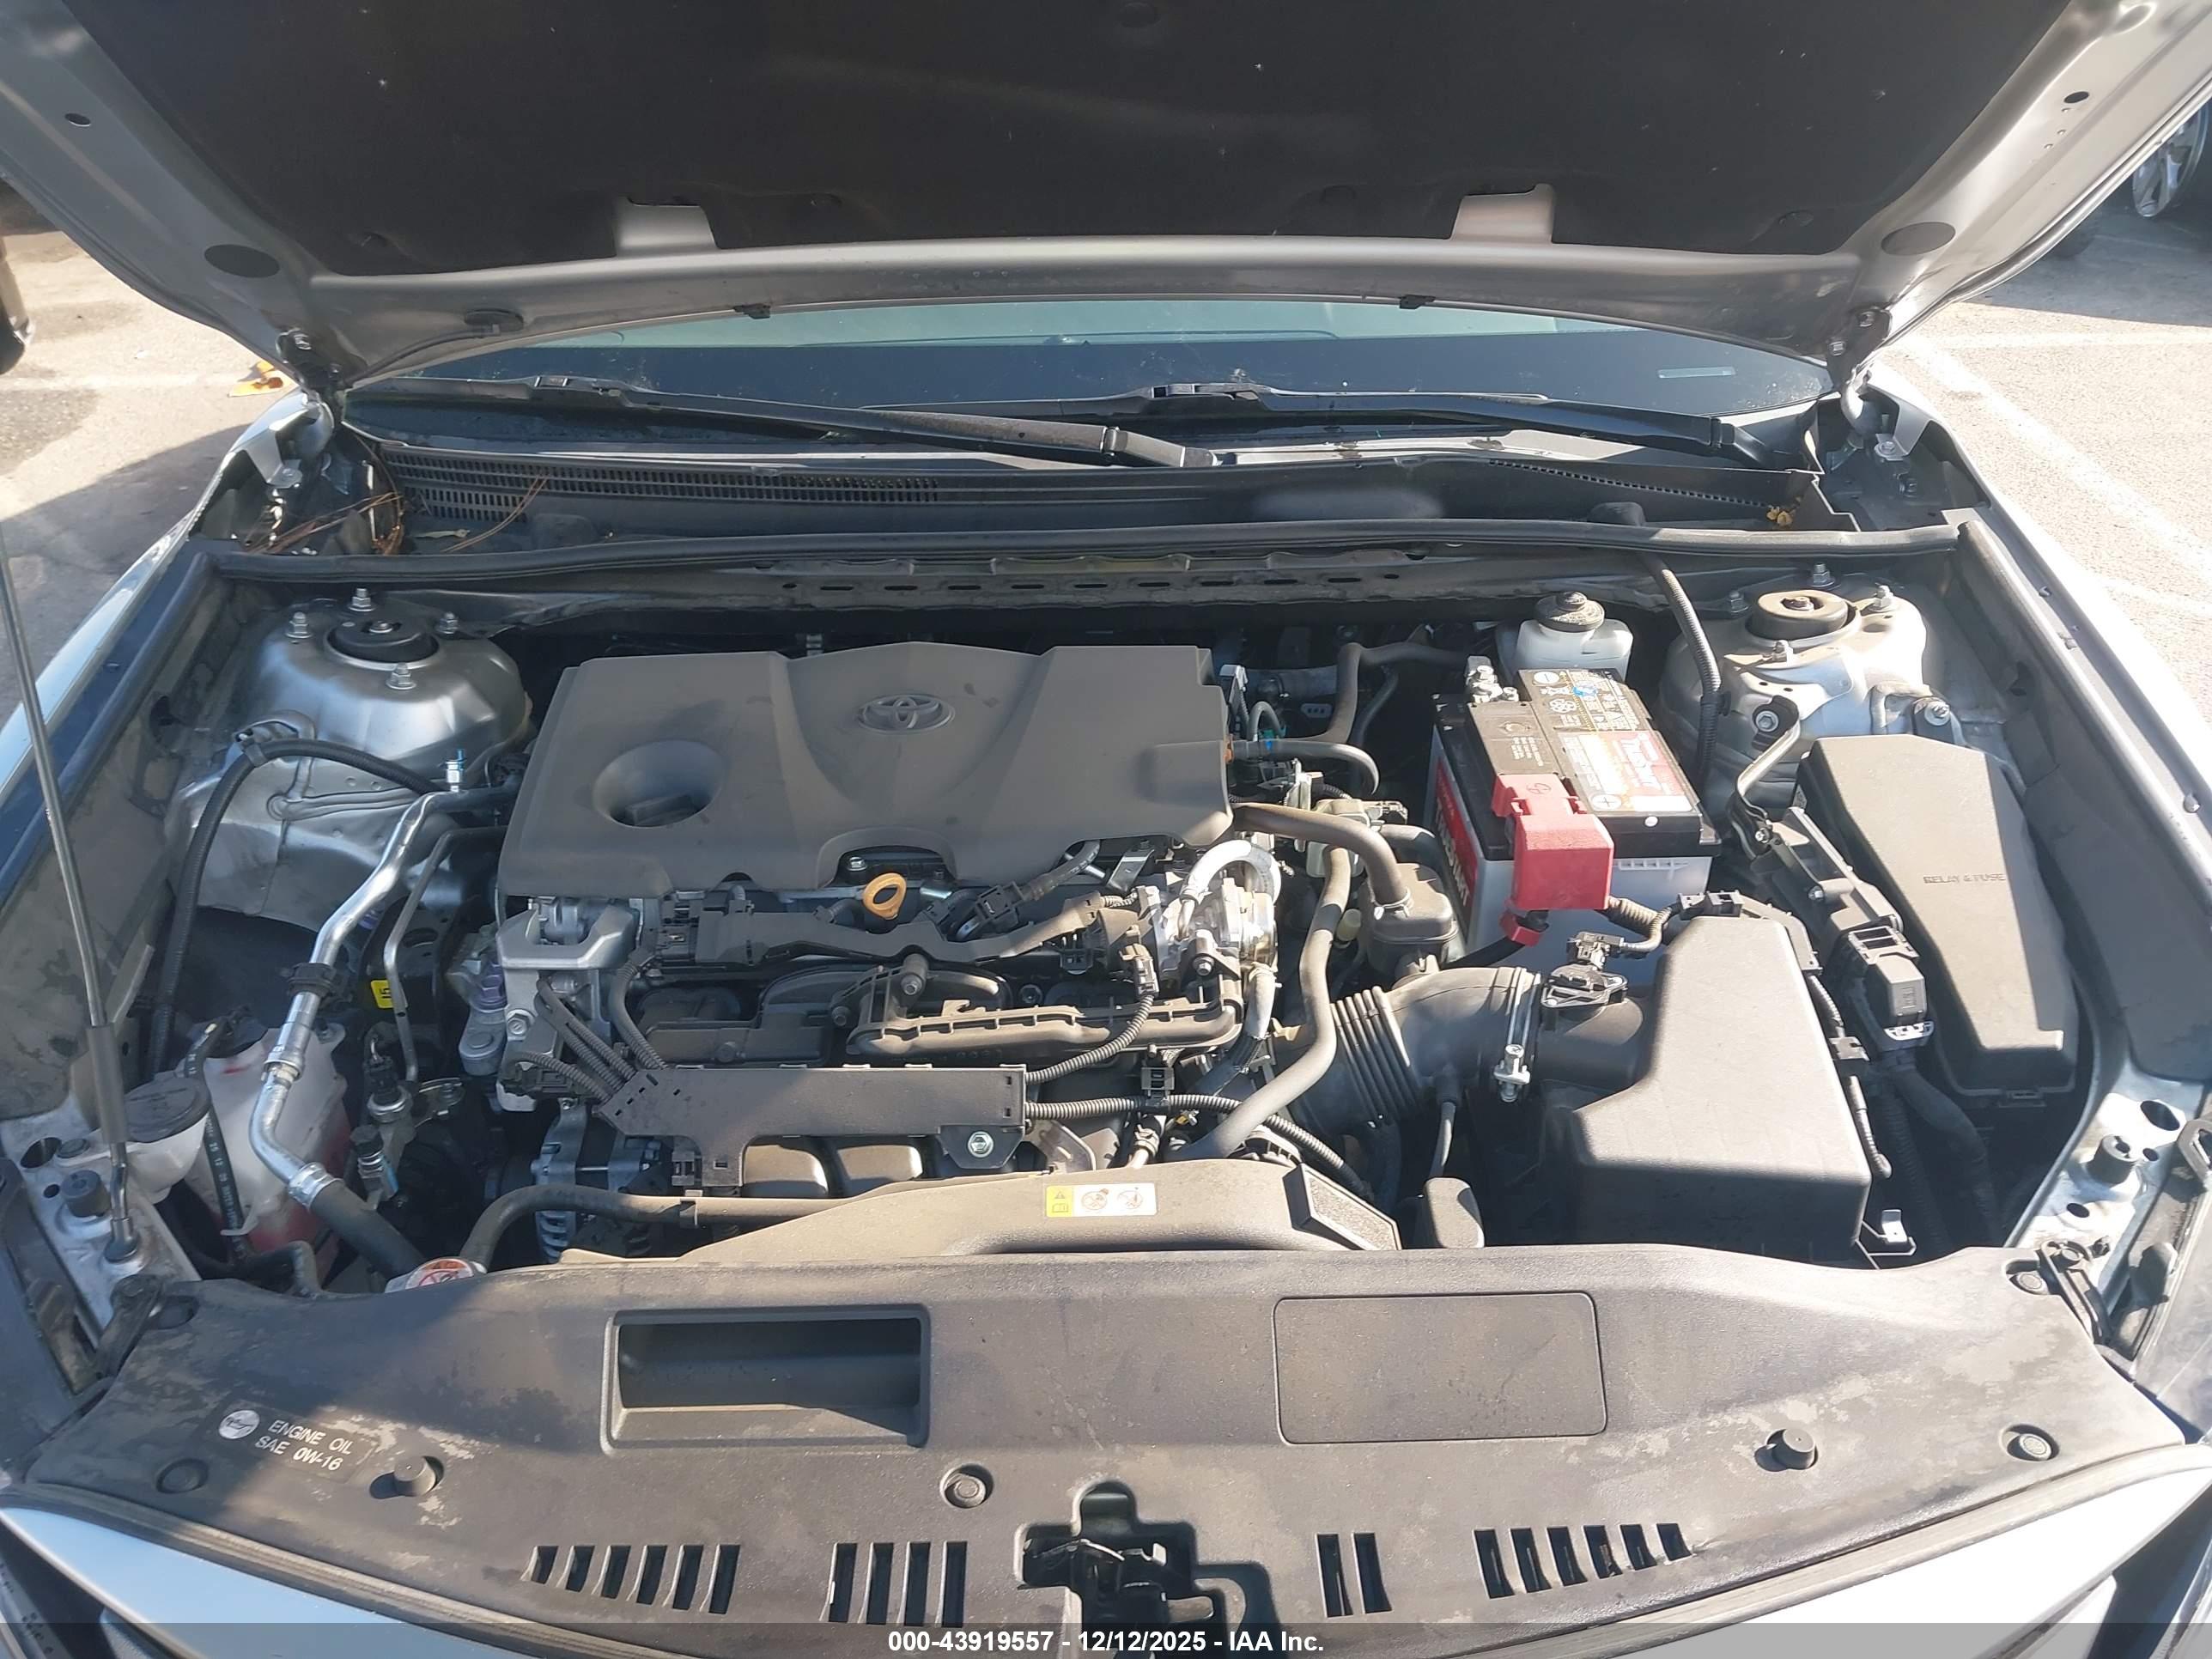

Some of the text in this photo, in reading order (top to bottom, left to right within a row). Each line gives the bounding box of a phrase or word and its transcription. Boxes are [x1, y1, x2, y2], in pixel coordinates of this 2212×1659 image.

[255, 1435, 343, 1471] SAE 0W-16
[268, 1419, 354, 1455] ENGINE OIL
